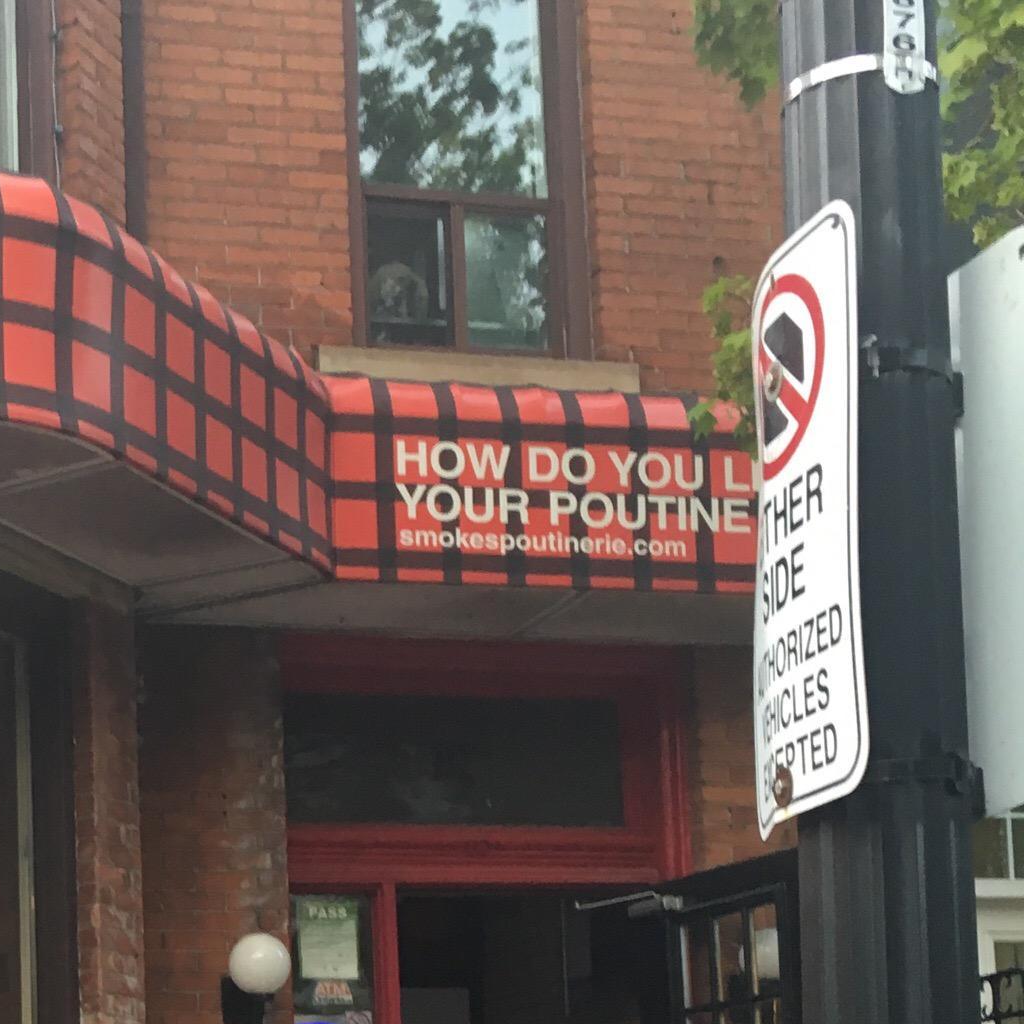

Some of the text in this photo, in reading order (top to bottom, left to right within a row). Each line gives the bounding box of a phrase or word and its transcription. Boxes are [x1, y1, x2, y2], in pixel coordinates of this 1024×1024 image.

[395, 440, 510, 480] HOW
[528, 446, 595, 485] DO
[608, 451, 705, 492] YOU
[394, 483, 753, 535] YOUR POUTINE
[398, 527, 687, 558] smokespoutinerie.com
[763, 542, 806, 625] SIDE
